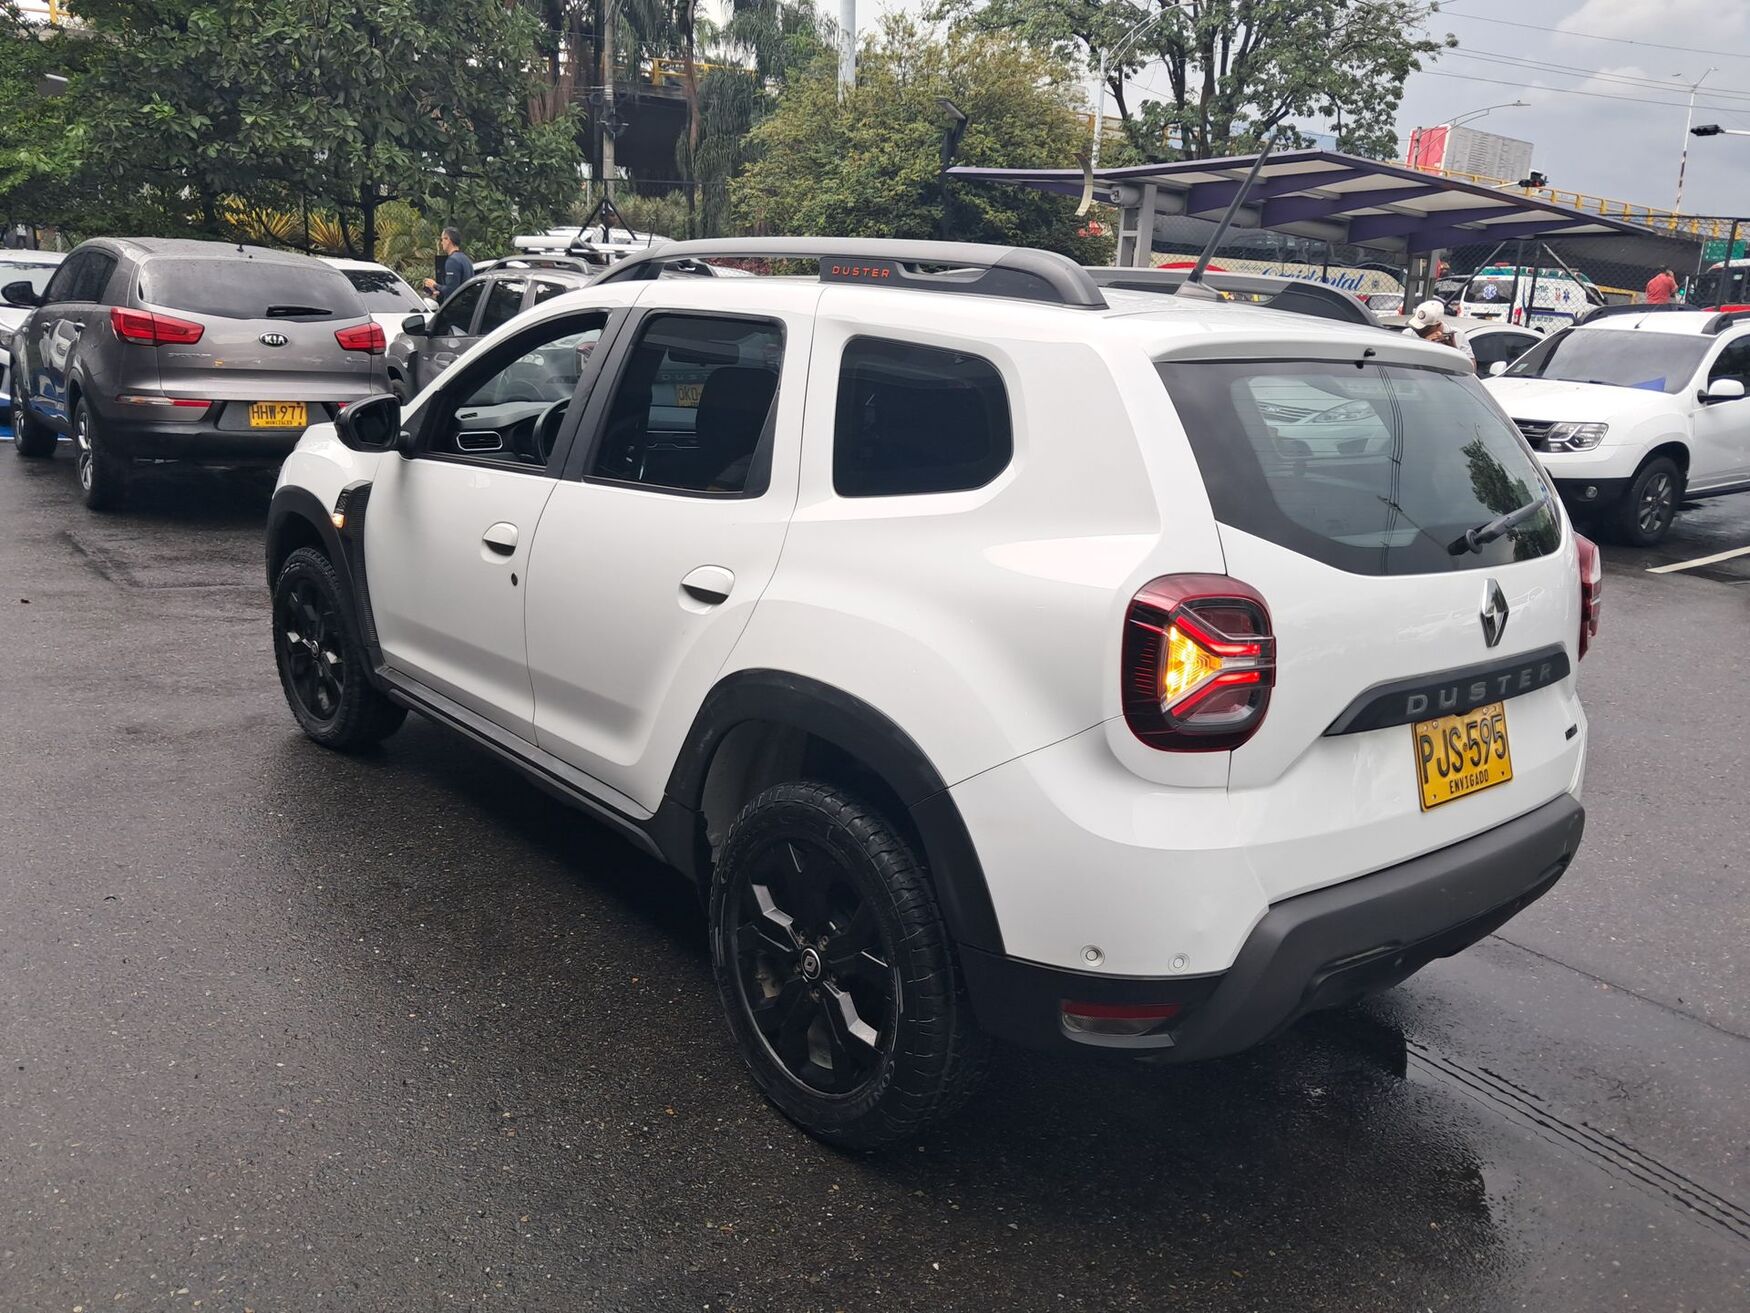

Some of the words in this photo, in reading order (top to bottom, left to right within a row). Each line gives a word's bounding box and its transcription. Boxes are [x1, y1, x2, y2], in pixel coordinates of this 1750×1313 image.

[831, 265, 890, 278] DUSTER
[264, 335, 285, 344] KIA
[1406, 663, 1552, 715] DUSTER
[1449, 768, 1490, 794] ENVIGADO
